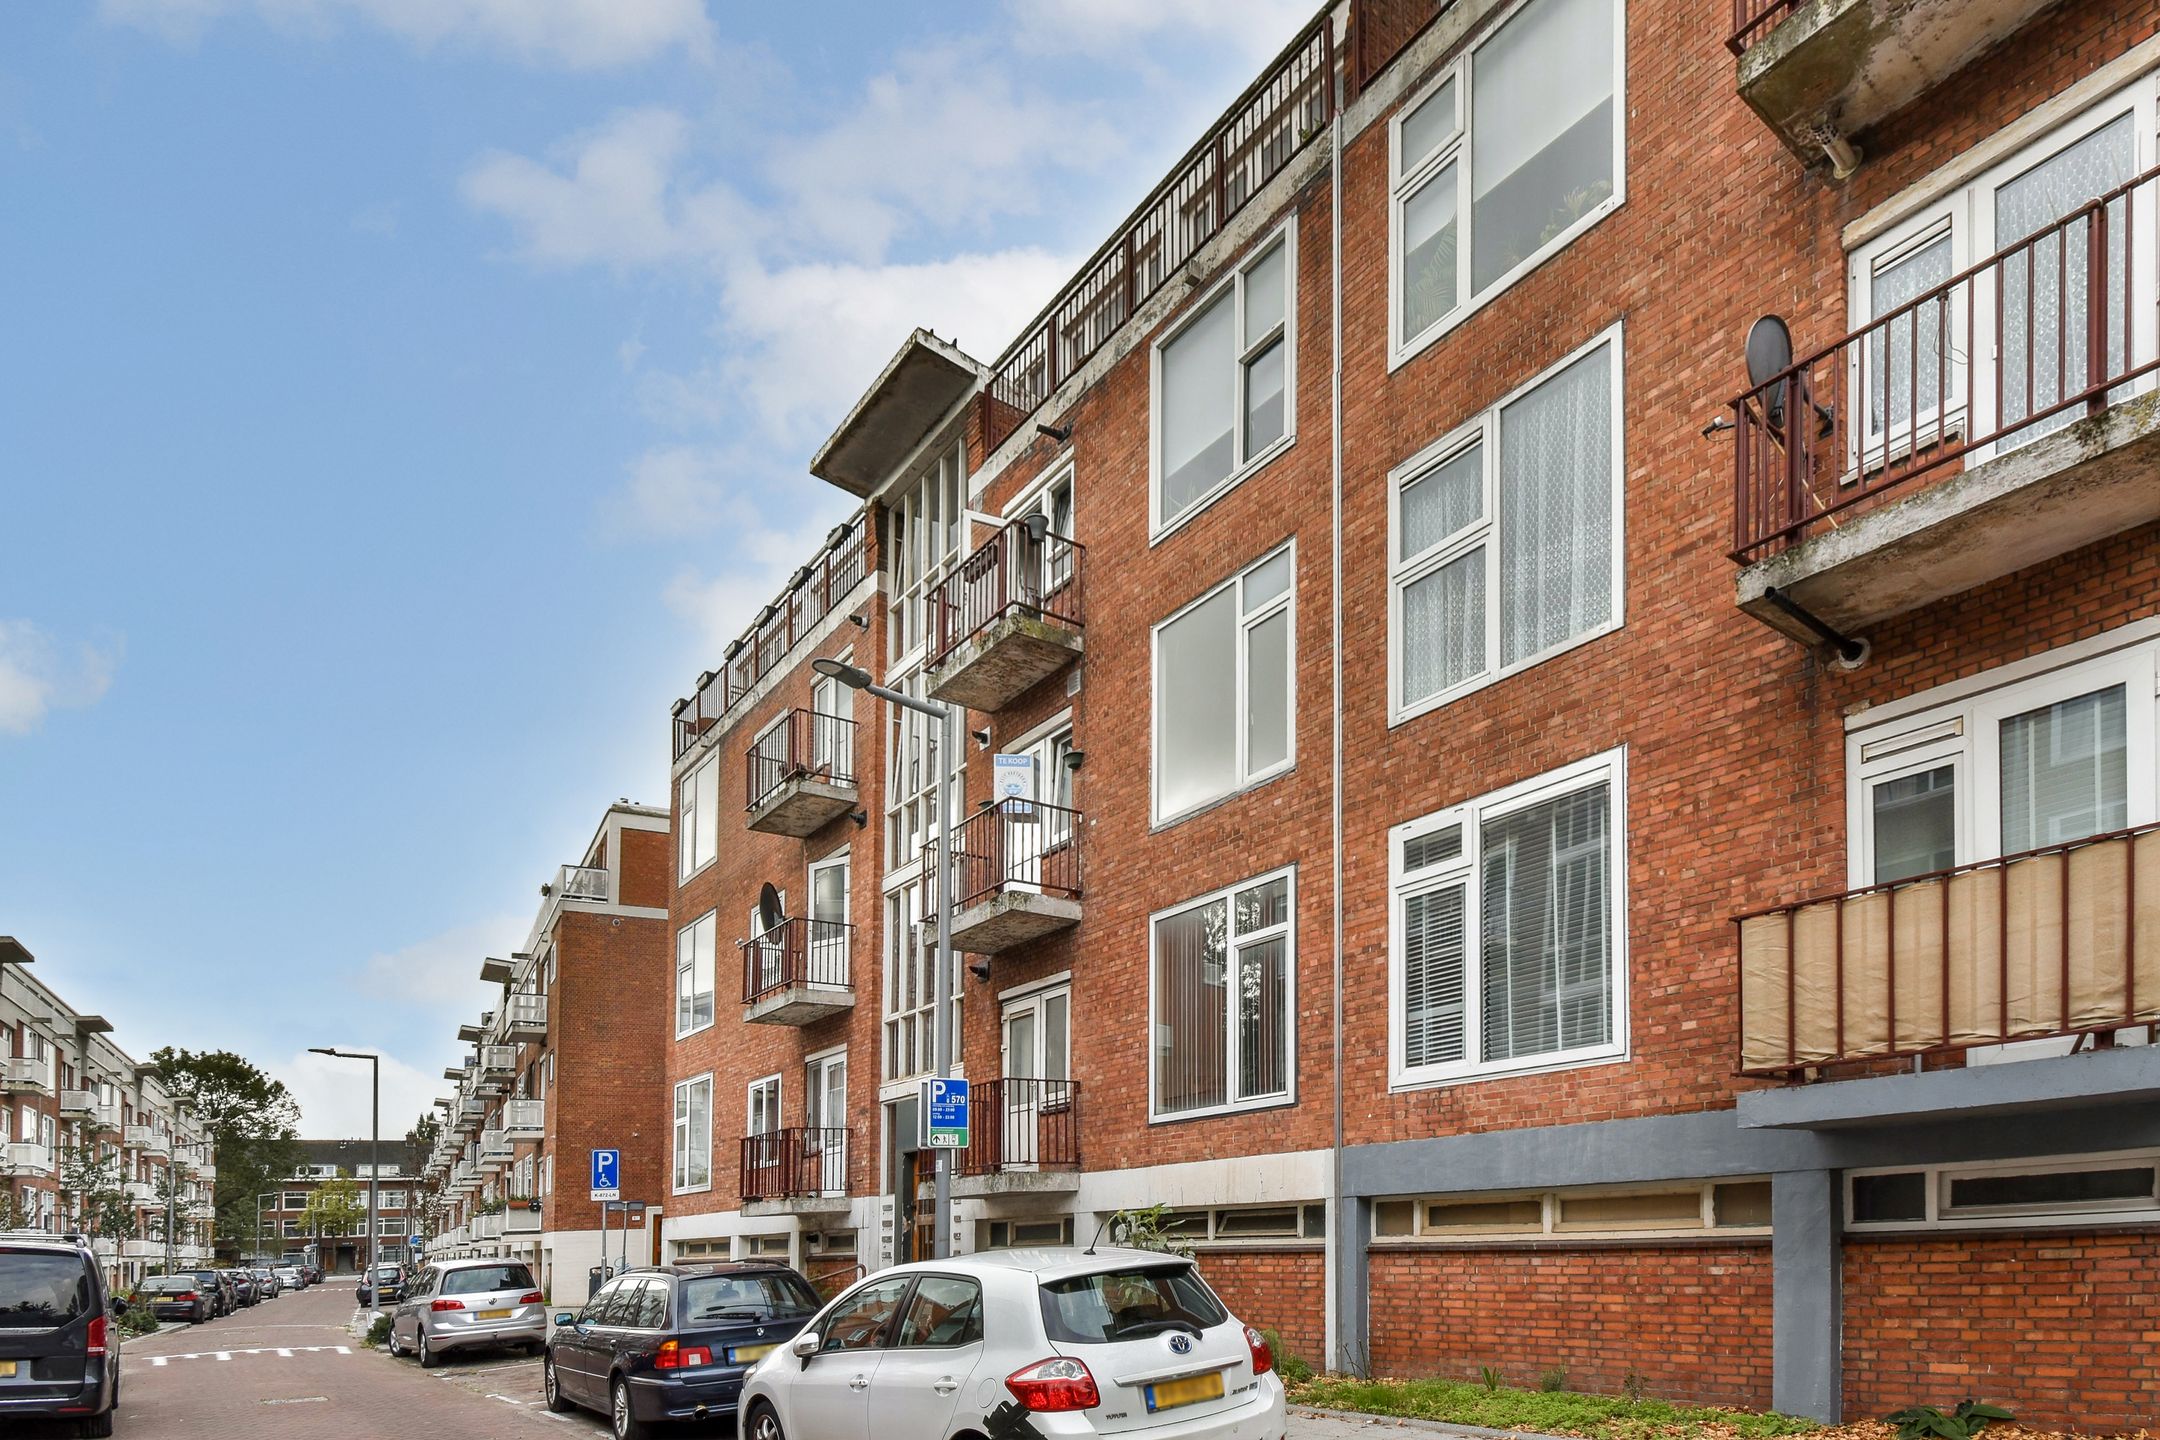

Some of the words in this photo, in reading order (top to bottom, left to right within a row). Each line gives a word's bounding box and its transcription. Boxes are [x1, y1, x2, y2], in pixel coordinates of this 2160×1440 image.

[998, 757, 1006, 765] TE
[1007, 757, 1028, 765] KOOP
[932, 1081, 946, 1103] P
[951, 1095, 966, 1103] 570
[598, 1152, 613, 1173] P
